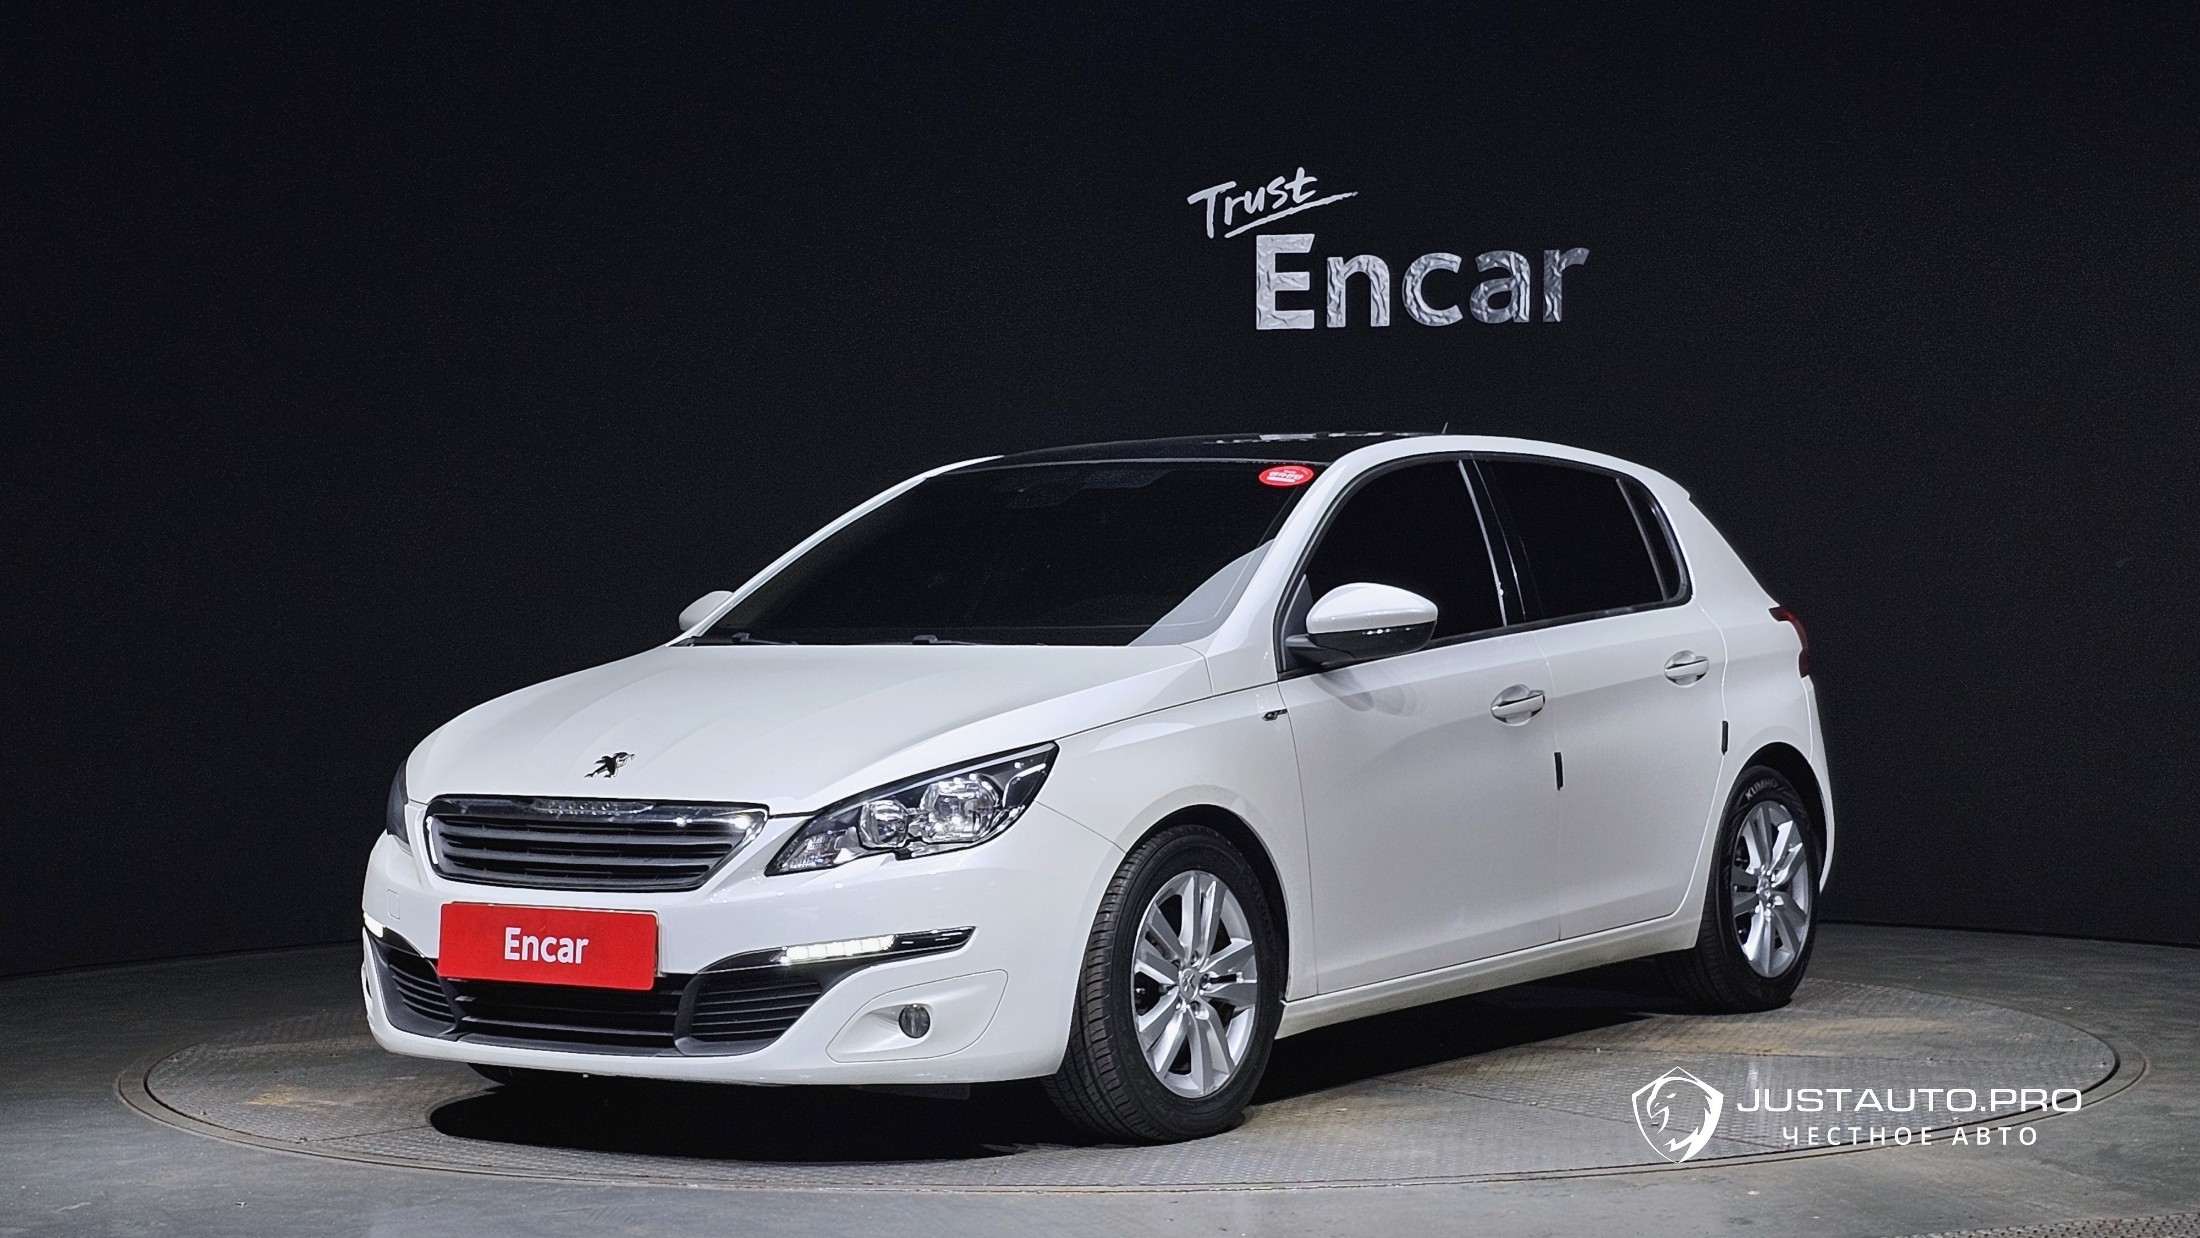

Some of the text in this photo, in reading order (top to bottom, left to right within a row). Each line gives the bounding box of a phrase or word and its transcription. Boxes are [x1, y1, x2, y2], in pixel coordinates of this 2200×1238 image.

[1187, 166, 1318, 239] Trust
[1256, 233, 1590, 330] Encar
[1745, 778, 1778, 801] KUMHO
[504, 927, 589, 964] Encar
